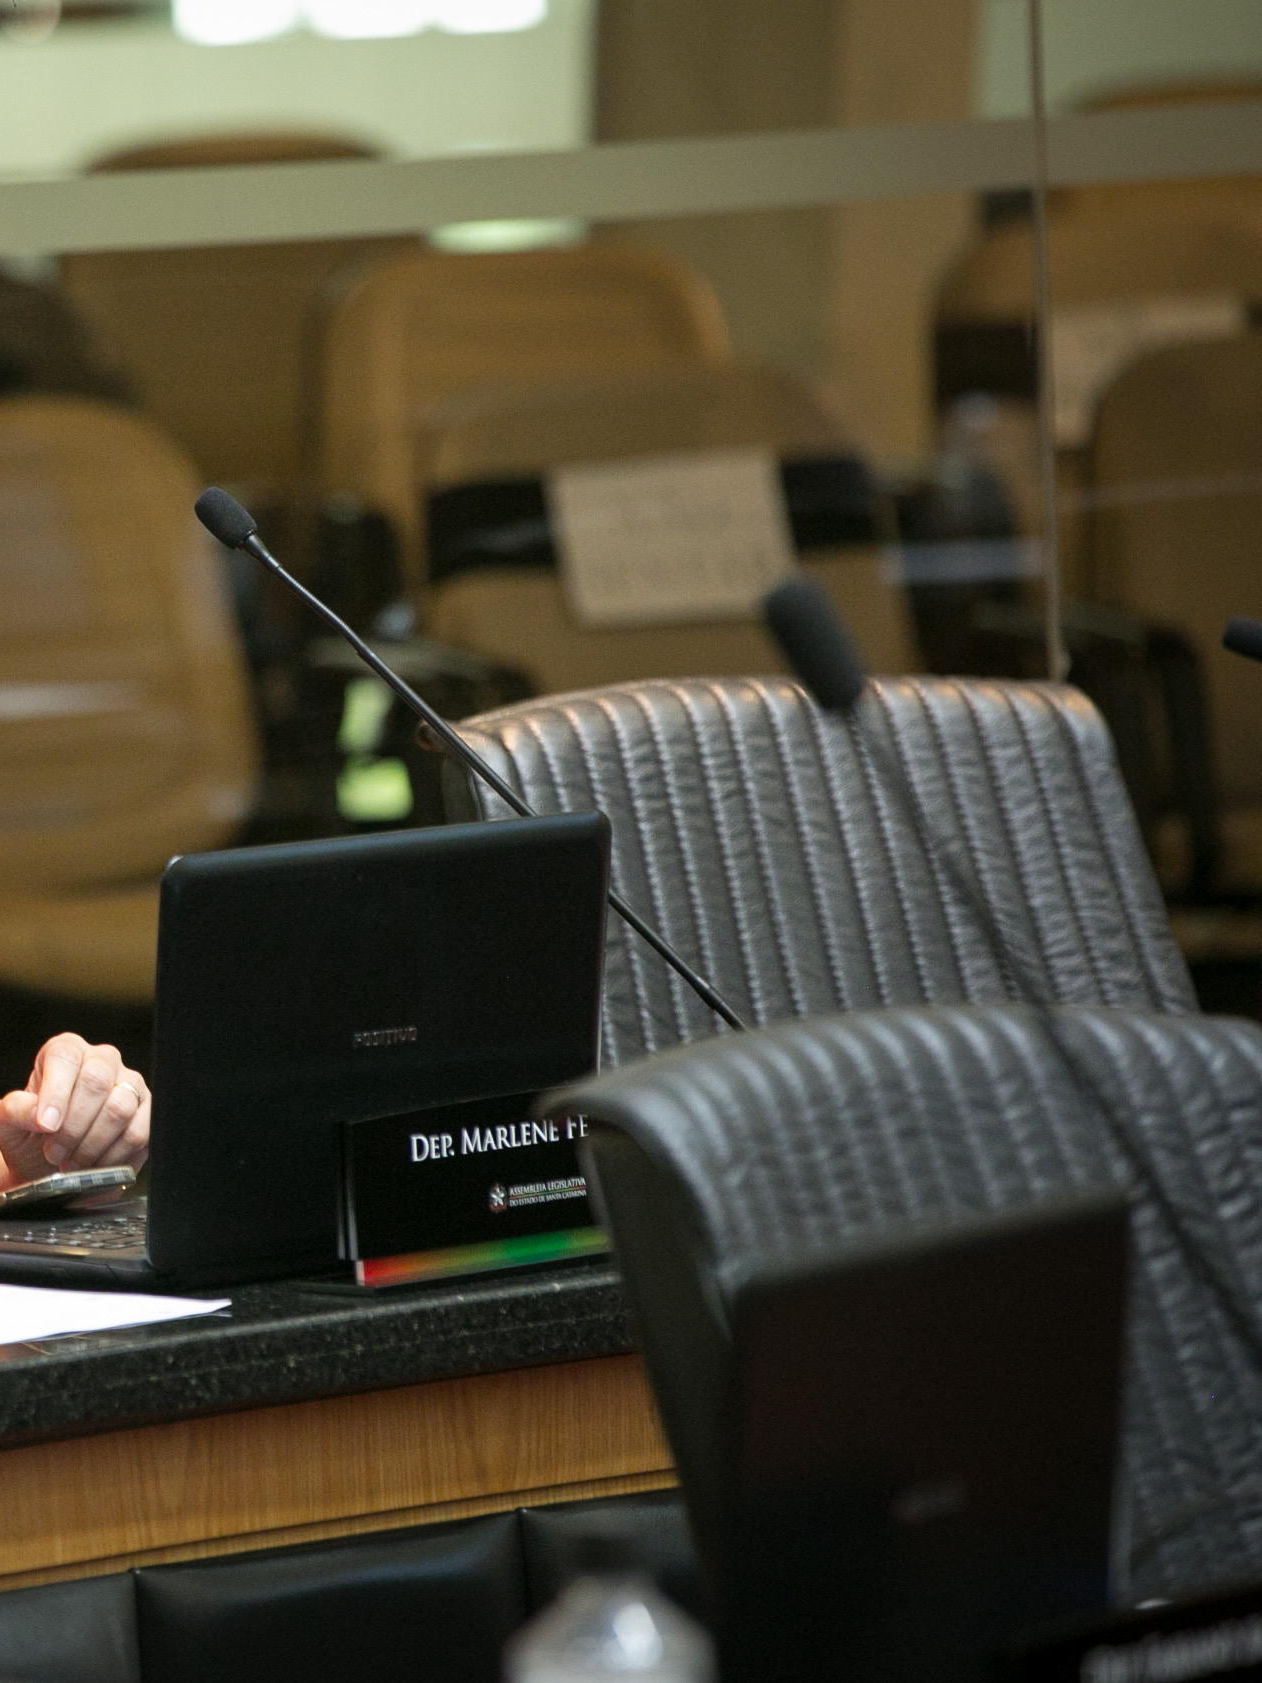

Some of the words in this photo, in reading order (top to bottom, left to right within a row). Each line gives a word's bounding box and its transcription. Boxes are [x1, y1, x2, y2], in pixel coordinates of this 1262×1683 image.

[461, 1119, 559, 1155] MARLENE
[509, 1184, 546, 1196] ASSEMBLEIA
[547, 1177, 586, 1190] LEGISLATIVA
